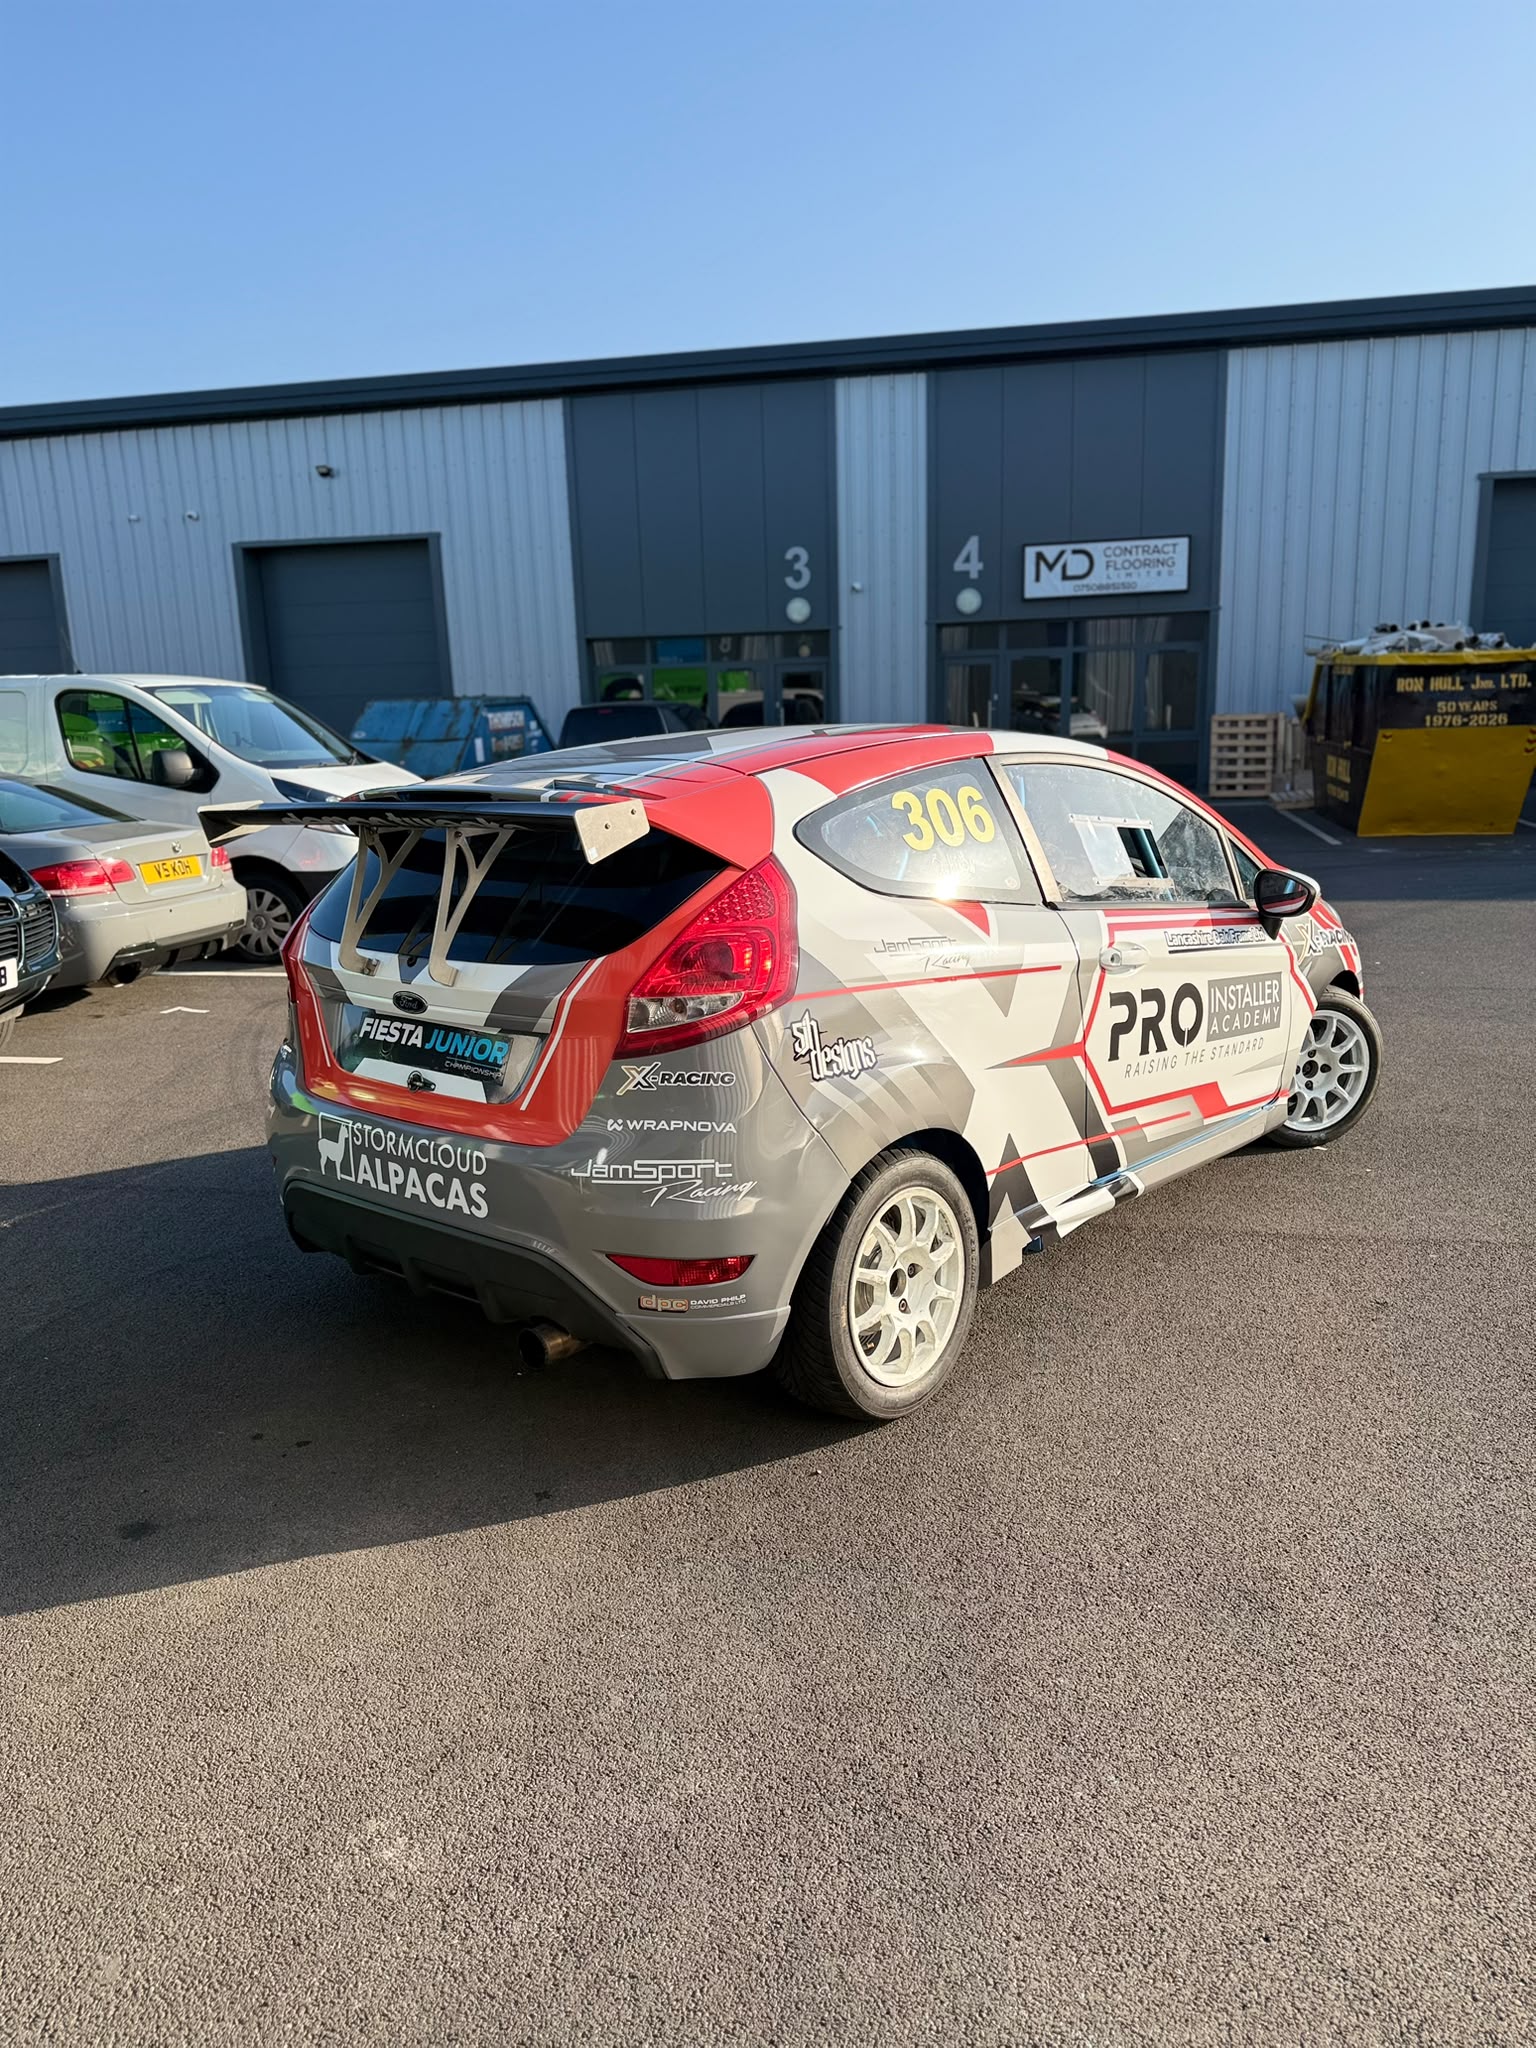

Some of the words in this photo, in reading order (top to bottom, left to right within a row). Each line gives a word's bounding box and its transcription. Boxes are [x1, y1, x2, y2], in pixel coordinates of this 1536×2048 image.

[953, 535, 984, 580] 4
[1103, 543, 1178, 558] CONTRACT
[1105, 556, 1176, 571] FLOORING
[784, 546, 811, 590] 3
[1034, 549, 1094, 583] MD
[1106, 570, 1174, 579] LIMITED
[1396, 677, 1424, 692] RON
[1430, 675, 1464, 692] HULL
[1425, 714, 1509, 727] 1976-2026
[1437, 701, 1457, 713] 50
[1458, 700, 1498, 712] YEARS
[892, 786, 995, 851] 306
[1164, 930, 1213, 947] Lancashire
[1108, 983, 1203, 1062] PRO
[1211, 979, 1280, 1013] INSTALLER
[1210, 1006, 1280, 1034] ACADEMY
[359, 1017, 423, 1048] FIESTA
[425, 1029, 508, 1064] JUNIOR
[1125, 1055, 1178, 1079] RAISING
[1184, 1049, 1205, 1066] THE
[1210, 1037, 1264, 1060] STANDARD
[616, 1062, 736, 1096] X-RACING
[626, 1119, 737, 1134] WRAPNOVA
[353, 1122, 487, 1175] STORMCLOUD
[571, 1159, 733, 1184] JamSport
[356, 1154, 489, 1218] ALPACAS
[642, 1179, 758, 1207] Racing
[641, 1294, 688, 1312] dpc
